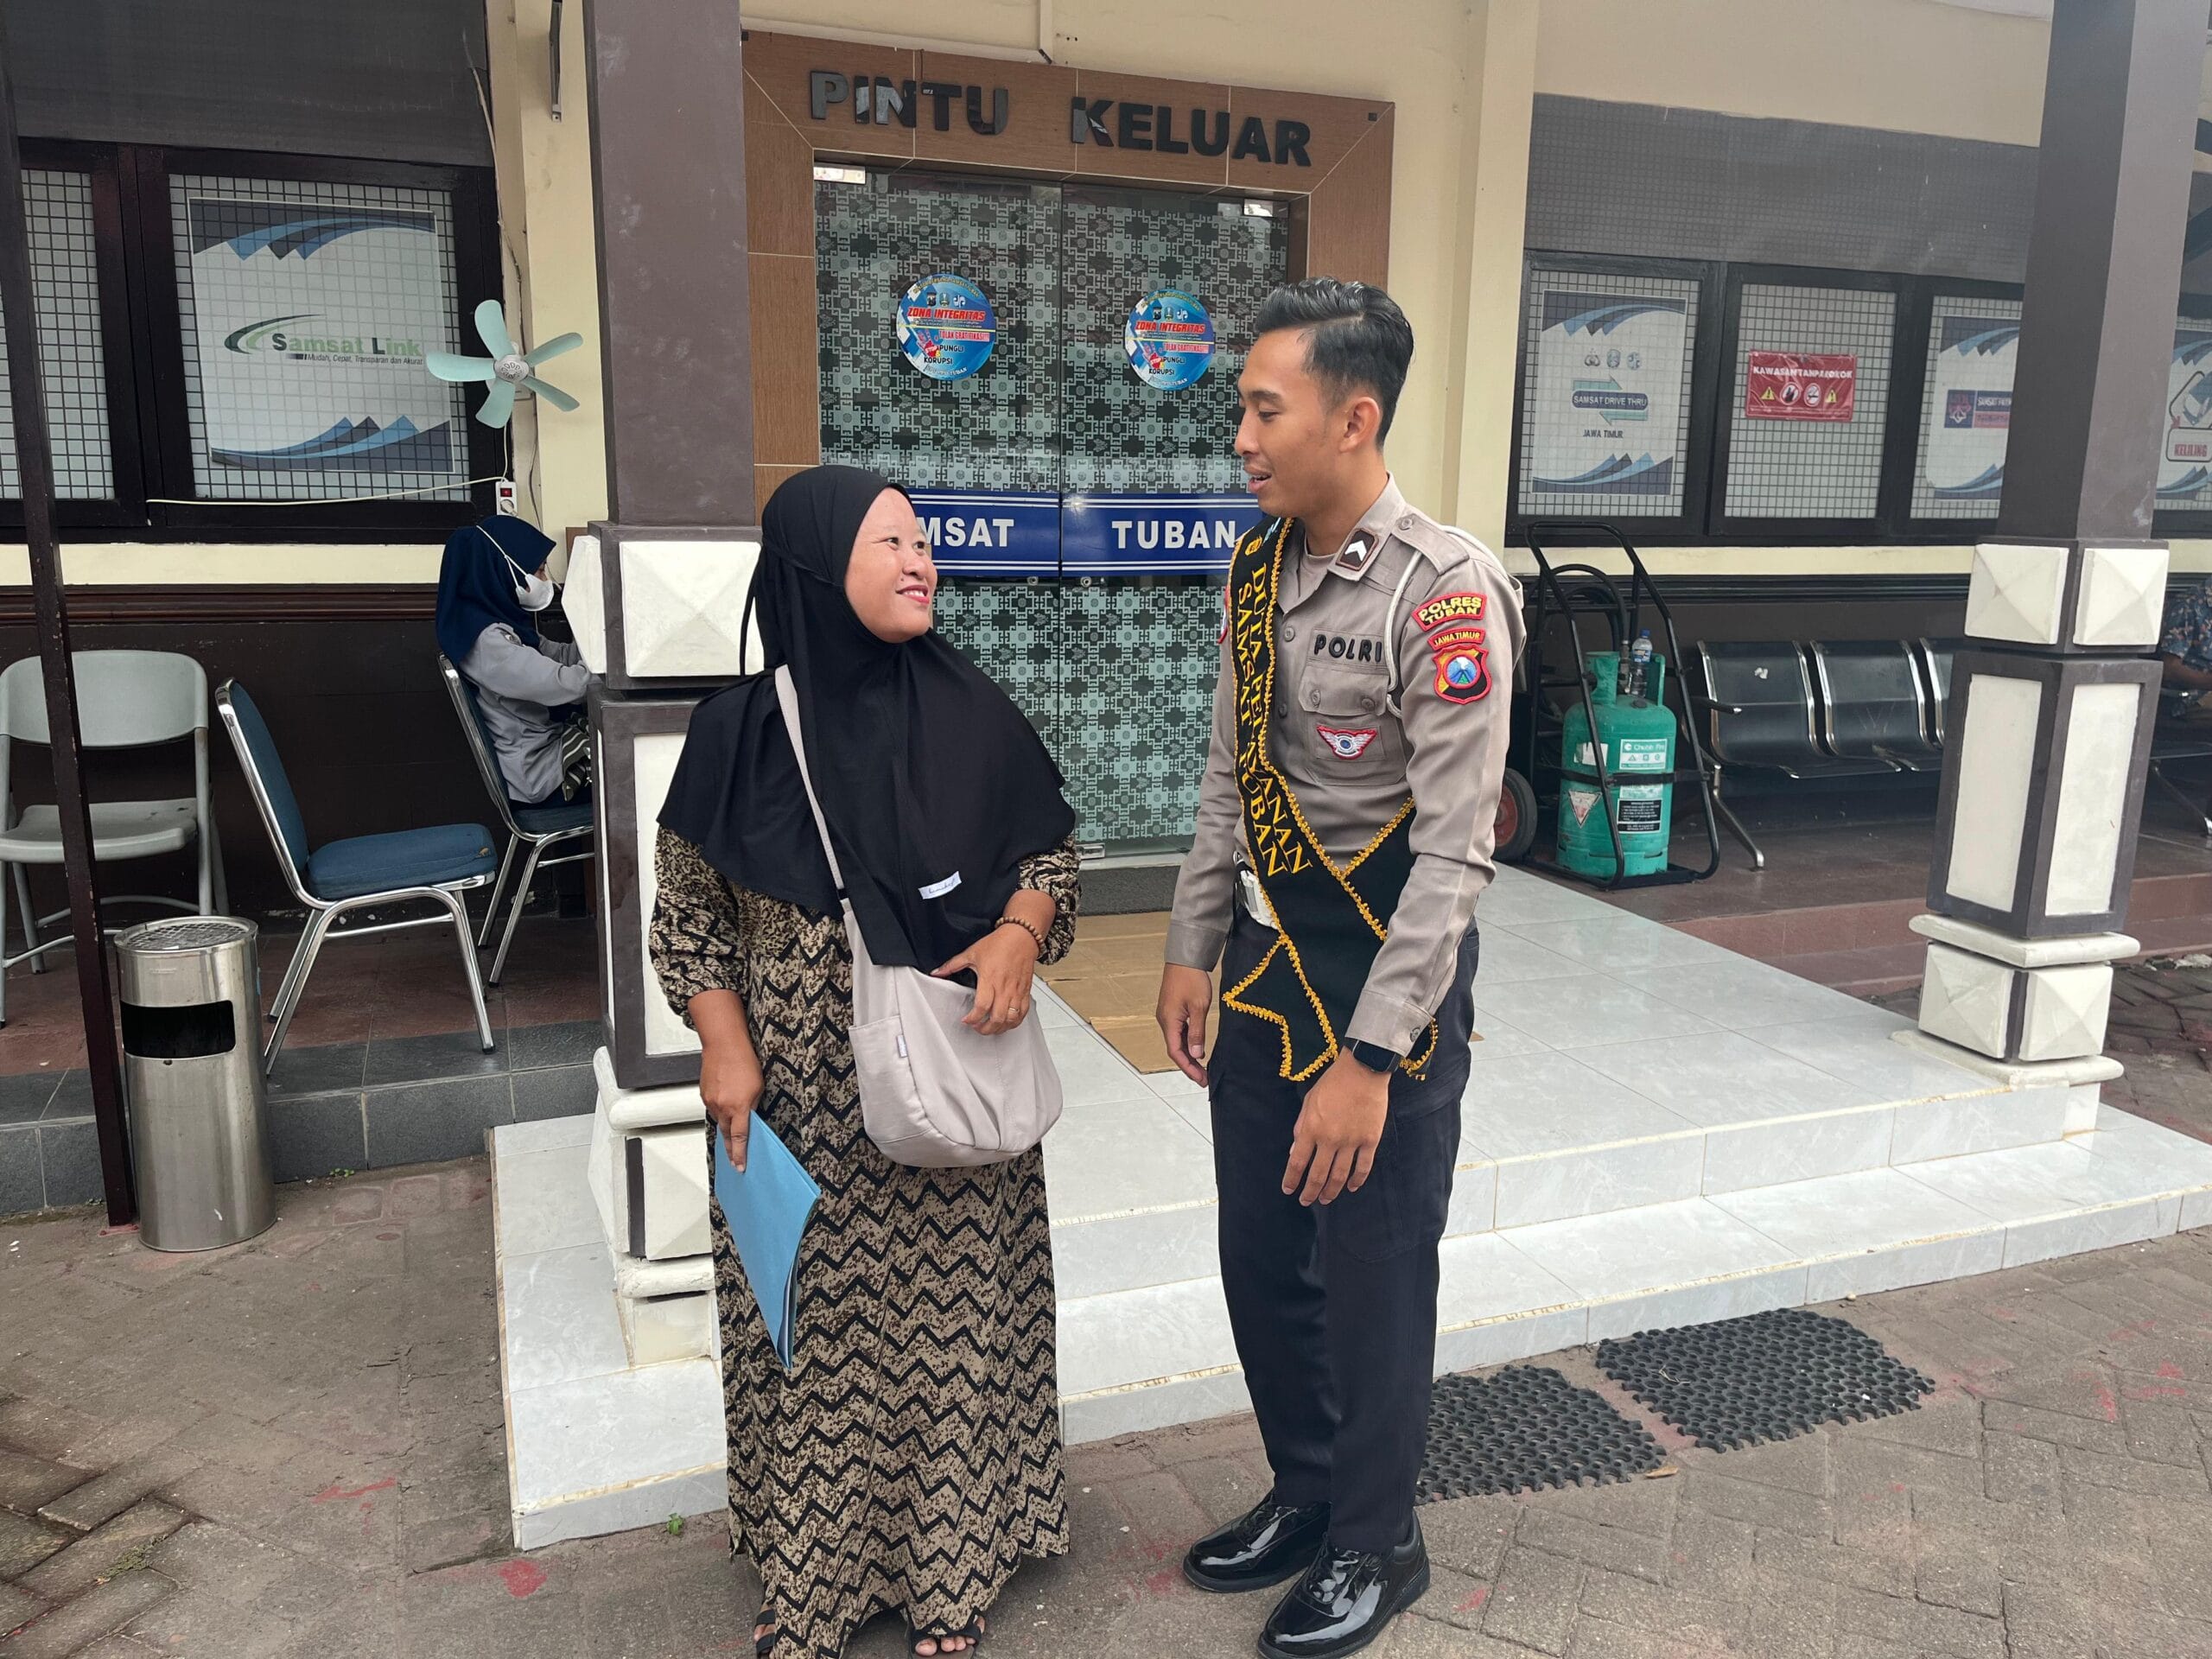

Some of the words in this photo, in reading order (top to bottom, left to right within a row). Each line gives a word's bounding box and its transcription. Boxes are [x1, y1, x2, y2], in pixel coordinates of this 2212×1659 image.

[810, 71, 1008, 136] PINTU
[1071, 97, 1311, 166] KELUAR
[907, 307, 931, 318] ZONA
[934, 308, 986, 321] INTEGRITAS
[1135, 321, 1157, 331] ZONA
[1160, 322, 1205, 334] INTEGRITAS
[271, 333, 364, 353] Samsat
[372, 337, 423, 356] Link
[355, 355, 389, 364] Transparan
[1573, 395, 1603, 404] SAMSAT
[1604, 397, 1625, 405] DRIVE
[1628, 397, 1647, 406] THRU
[1583, 429, 1602, 438] JAWA
[1604, 429, 1624, 439] TIMUR
[917, 517, 1014, 548] MSAT
[1111, 520, 1236, 550] TUBAN
[1250, 563, 1268, 663] DUTA
[1418, 596, 1482, 621] POLRES
[1425, 607, 1478, 624] TUBAN
[1314, 634, 1382, 663] POLRI
[1434, 632, 1455, 646] JAWA
[1455, 631, 1480, 641] TIMUR
[1237, 582, 1255, 726] SAMSAT
